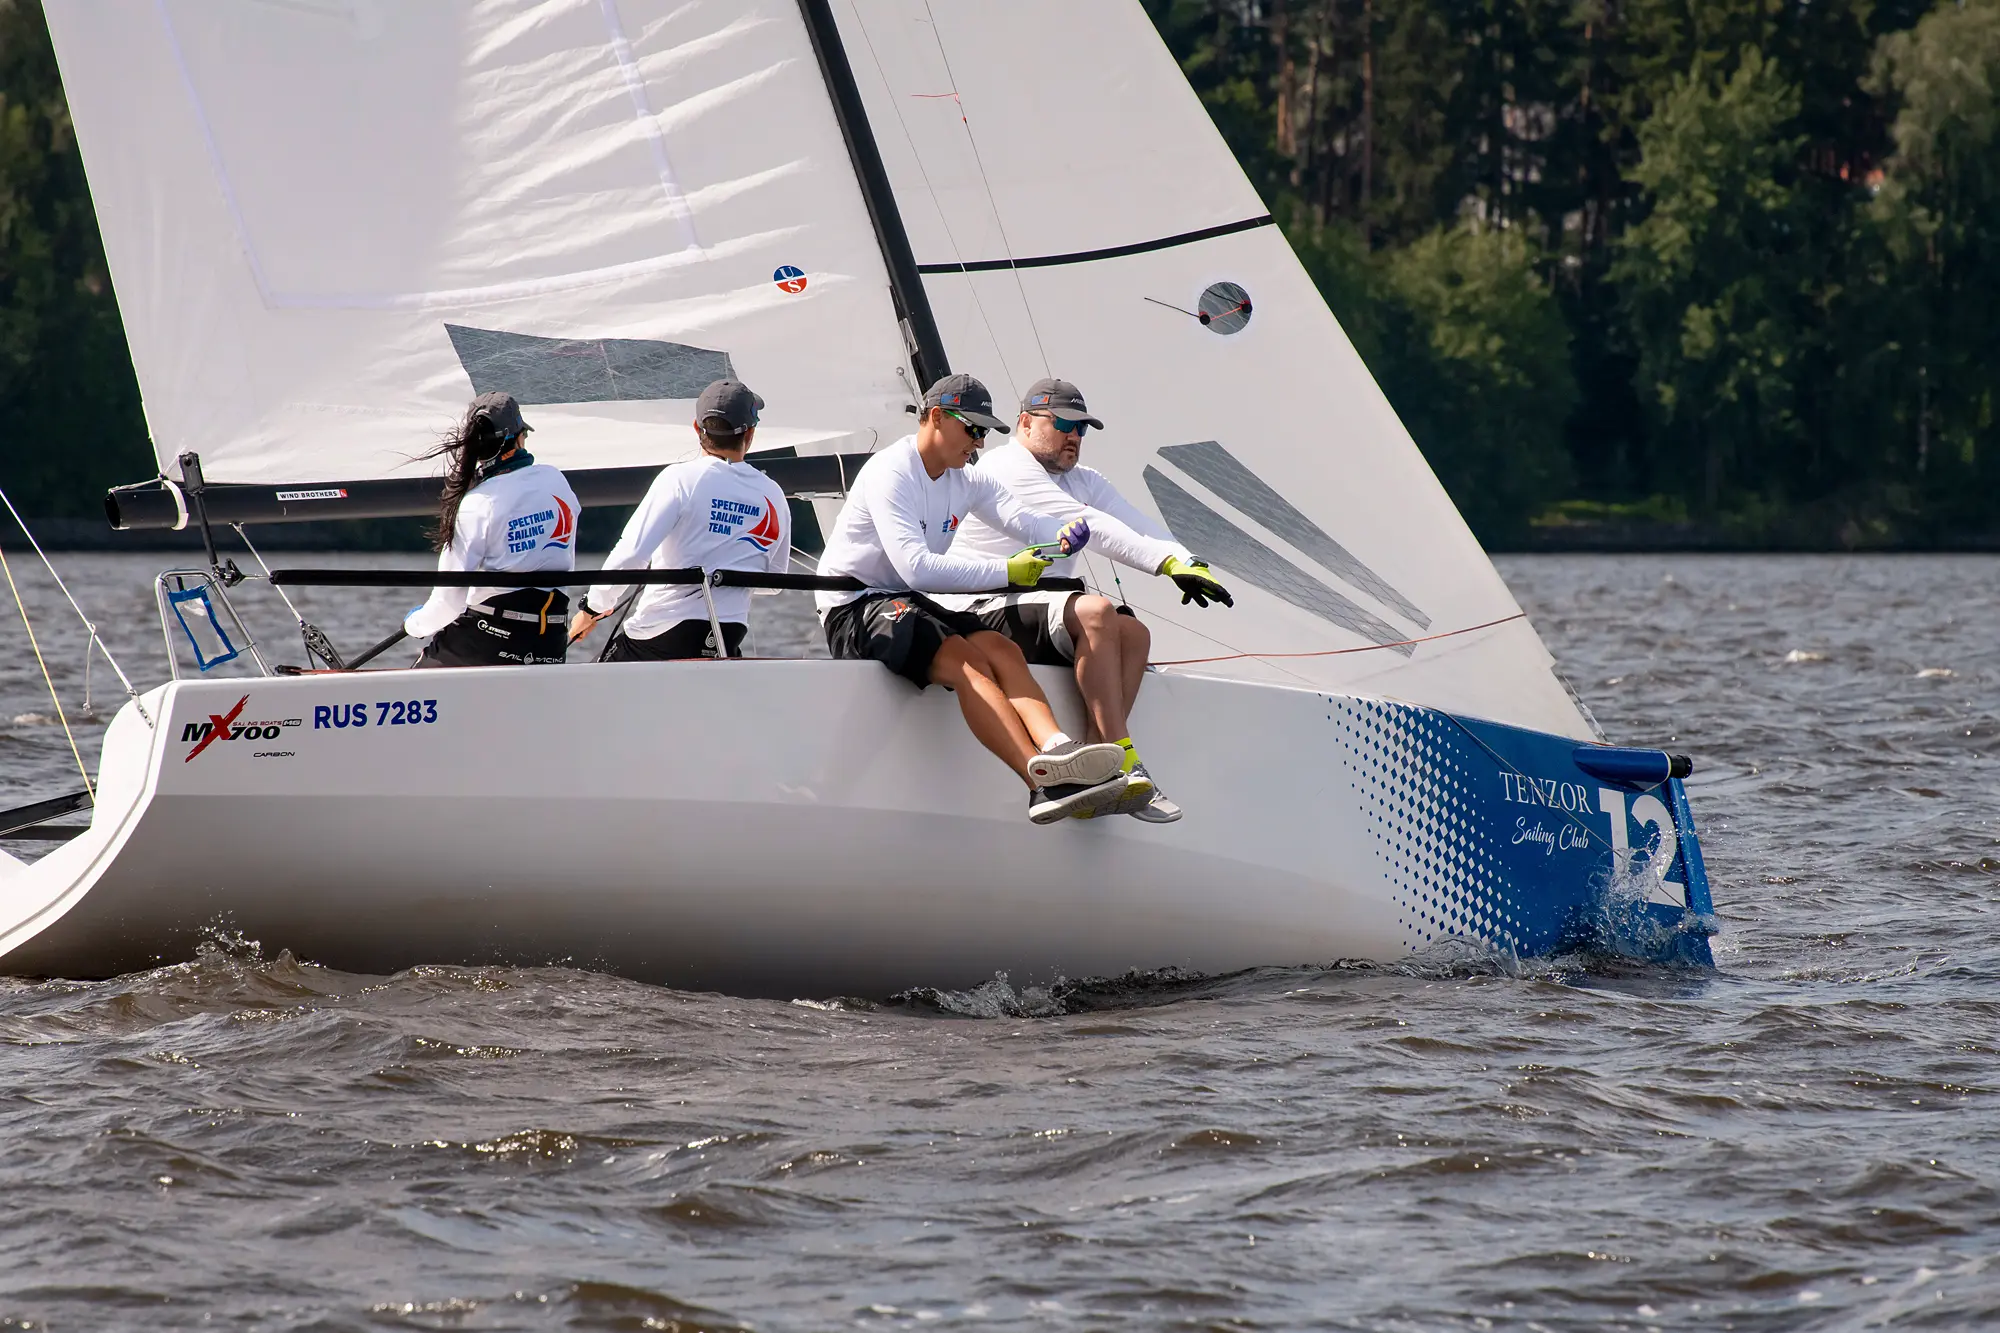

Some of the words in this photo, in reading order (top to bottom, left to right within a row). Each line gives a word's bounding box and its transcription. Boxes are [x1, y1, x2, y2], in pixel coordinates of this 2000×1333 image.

[711, 498, 760, 517] SPECTRUM
[508, 509, 554, 531] SPECTRUM
[710, 510, 744, 526] SAILING
[508, 524, 545, 542] SAILING
[708, 522, 732, 536] TEAM
[508, 538, 536, 553] TEAM
[498, 651, 523, 662] SAIL
[314, 703, 368, 729] RUS
[375, 699, 438, 727] 7283
[1498, 770, 1594, 815] TENZOR
[1511, 816, 1555, 856] Sailing
[1559, 823, 1589, 851] Club
[1599, 787, 1687, 908] 12
